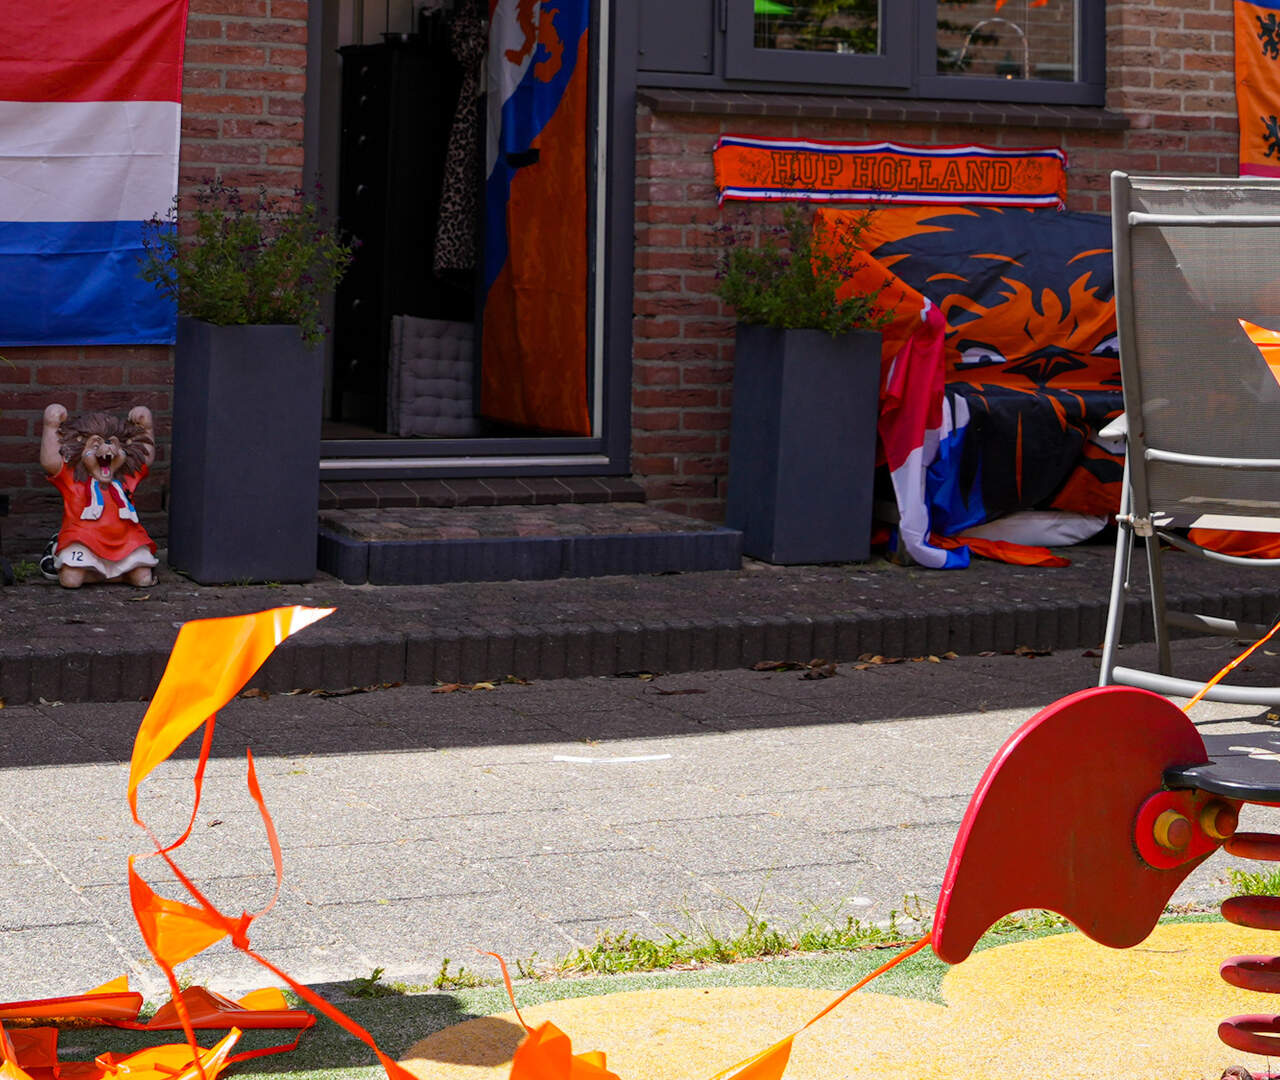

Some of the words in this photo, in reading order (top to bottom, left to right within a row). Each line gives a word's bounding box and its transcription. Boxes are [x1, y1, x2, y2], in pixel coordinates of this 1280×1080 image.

[770, 151, 843, 188] HUP
[852, 155, 1013, 193] HOLLAND
[71, 551, 84, 562] 12
